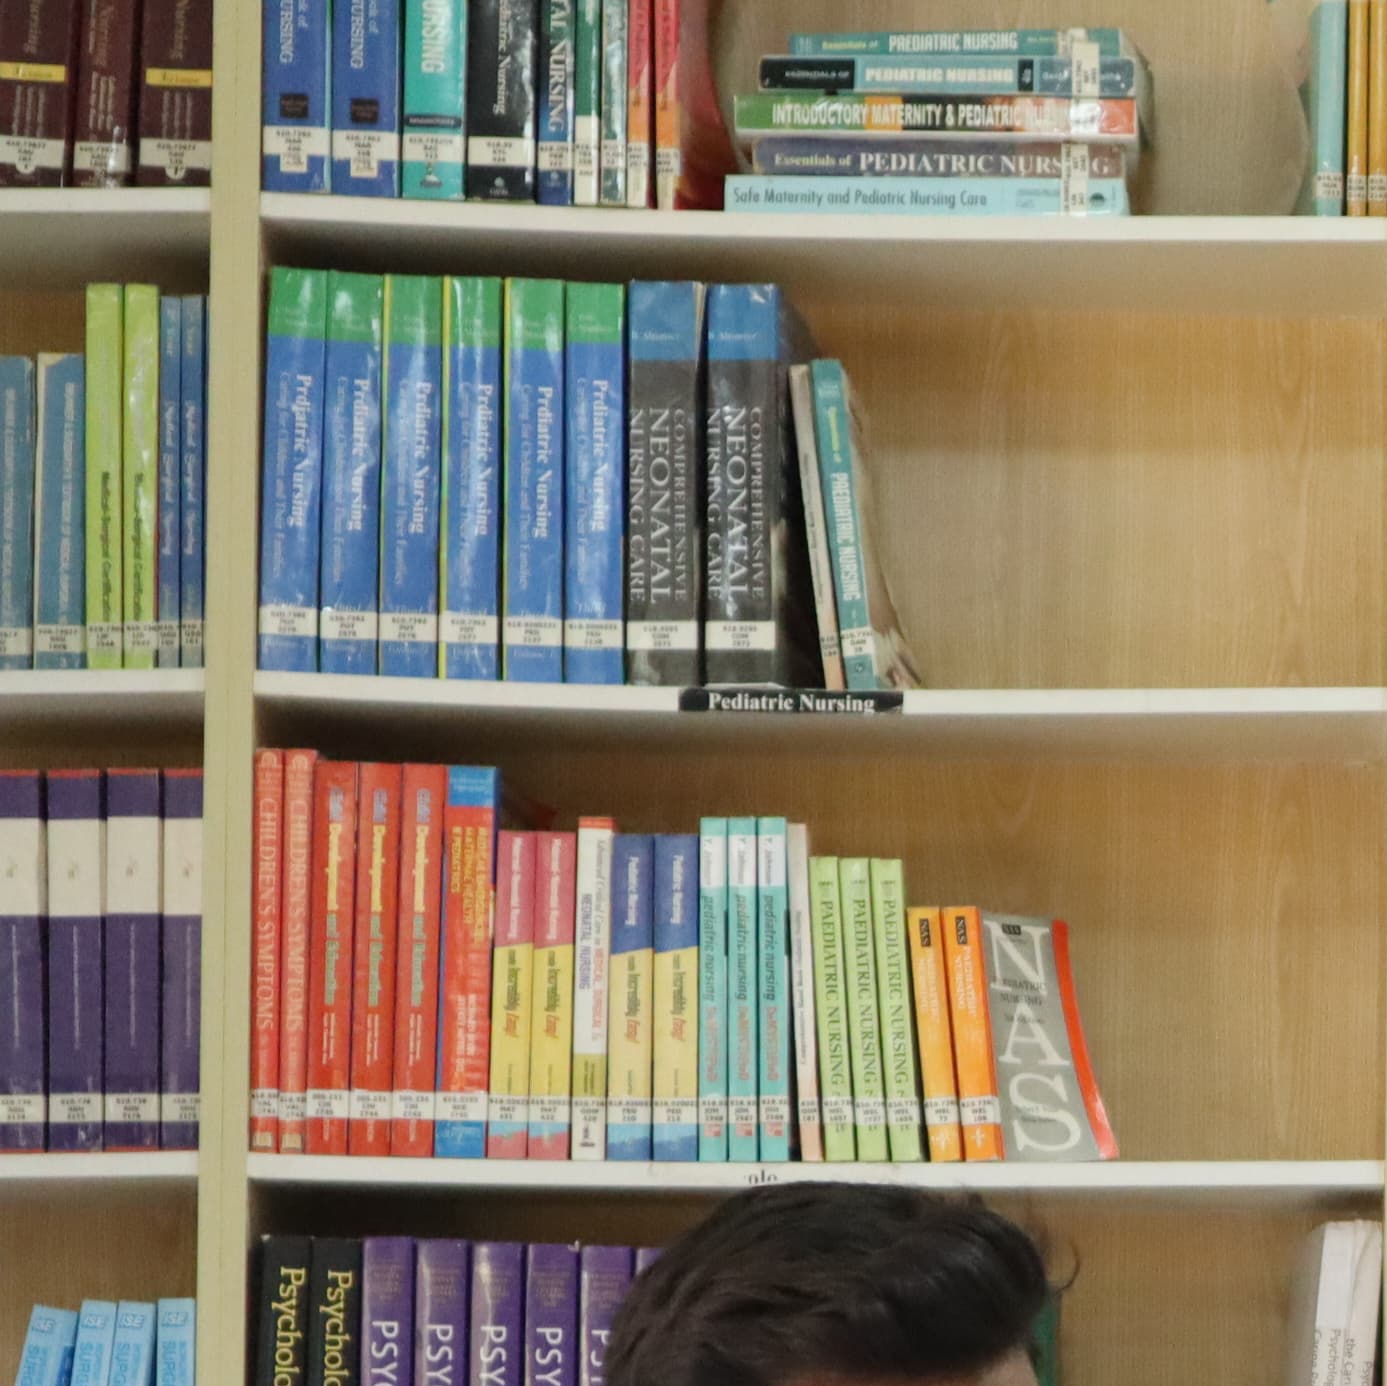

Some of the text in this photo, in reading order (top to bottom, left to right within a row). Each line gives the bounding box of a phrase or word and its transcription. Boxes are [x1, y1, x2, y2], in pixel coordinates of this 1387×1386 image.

[772, 104, 866, 126] INTRODUCTORY
[867, 104, 941, 126] MATERNITY
[945, 105, 955, 126] &
[958, 104, 1019, 126] PEDIATRIC
[865, 67, 1014, 84] PEDIATRIC NURSING
[734, 188, 987, 208] Safe Maternity and Pediatric Nursing Care
[629, 409, 644, 601] NURSING CARE
[649, 408, 672, 604] NEONATAL
[673, 409, 686, 599] COMPREHENSIVE
[707, 408, 722, 599] NURSING CARE
[726, 407, 750, 601] NEONATAL
[751, 407, 763, 598] COMPREHENSIVE
[709, 692, 875, 713] Pediatric Nursing
[257, 798, 276, 1029] CHILDREN'S SYMPTOMS
[288, 800, 308, 1031] CHILDREN'S SYMPTOMS
[579, 894, 593, 989] NEONATAL NURSING
[820, 901, 844, 1085] PAEDIATRIC NURSING
[852, 900, 876, 1083] PAEDIATRIC NURSING
[884, 900, 909, 1083] PAEDIATRIC NURSING
[920, 921, 931, 945] NAS
[956, 919, 967, 943] NAS
[1344, 1338, 1356, 1358] the
